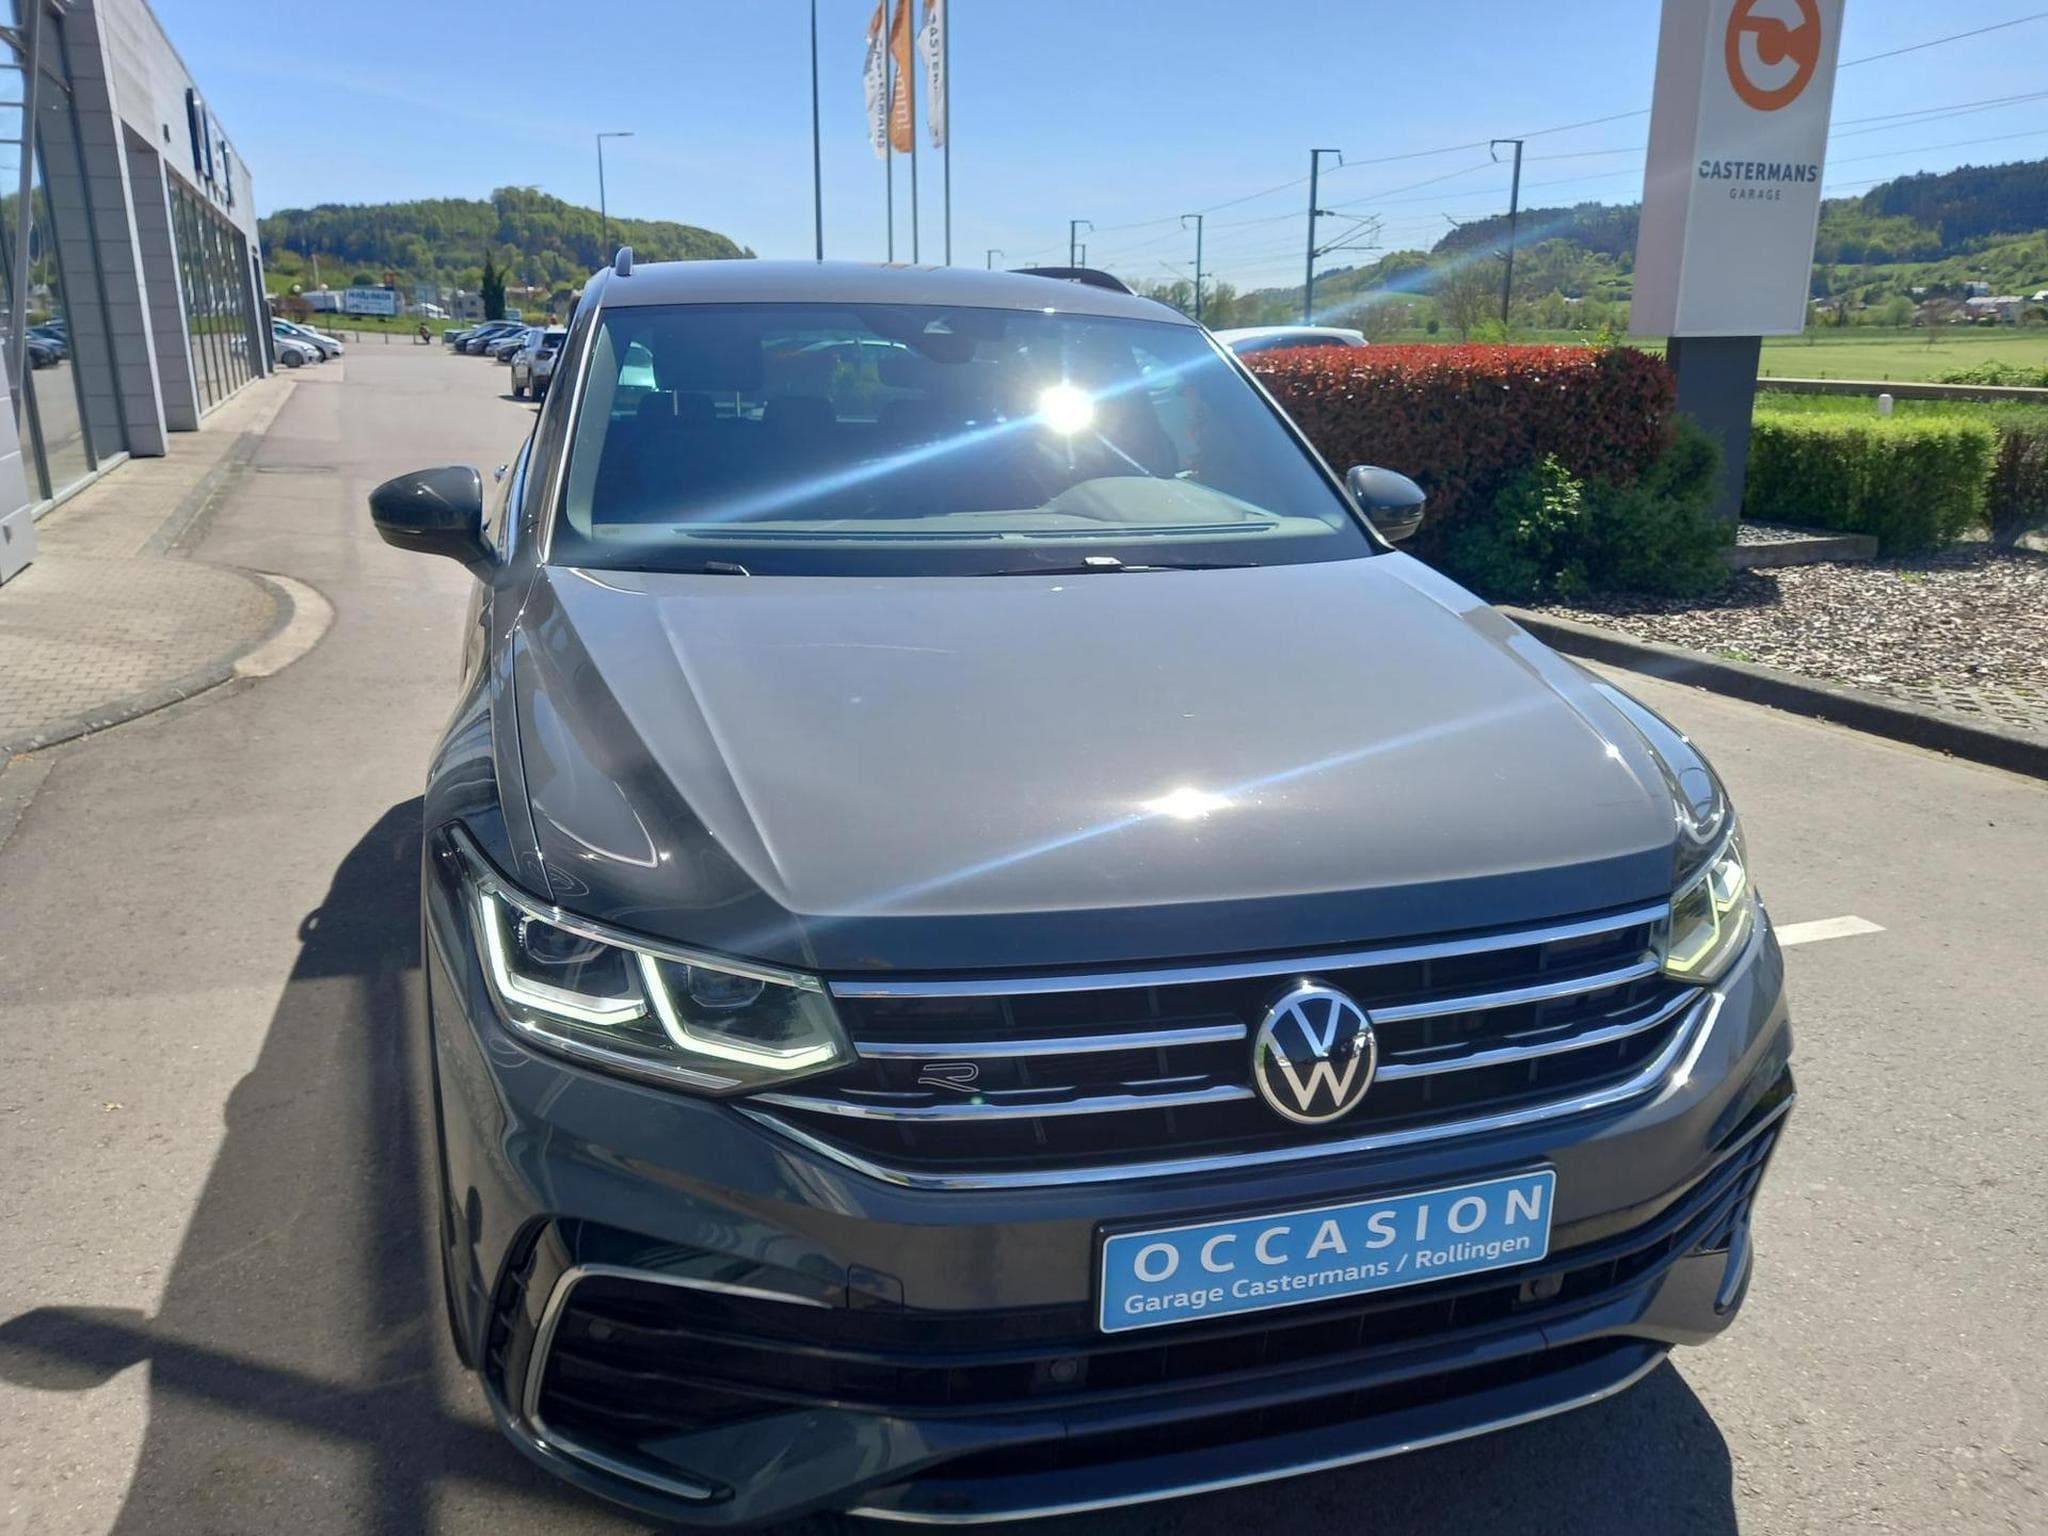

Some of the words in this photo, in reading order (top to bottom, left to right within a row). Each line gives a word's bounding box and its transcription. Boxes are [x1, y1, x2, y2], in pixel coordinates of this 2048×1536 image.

[1699, 160, 1819, 183] CASTERMANS
[1729, 187, 1781, 201] GARAGE
[1133, 1184, 1543, 1283] OCCASION
[1124, 1287, 1224, 1315] Garage
[1231, 1261, 1390, 1298] Castermans
[1396, 1253, 1409, 1273] /
[1415, 1236, 1530, 1270] Rollingen
